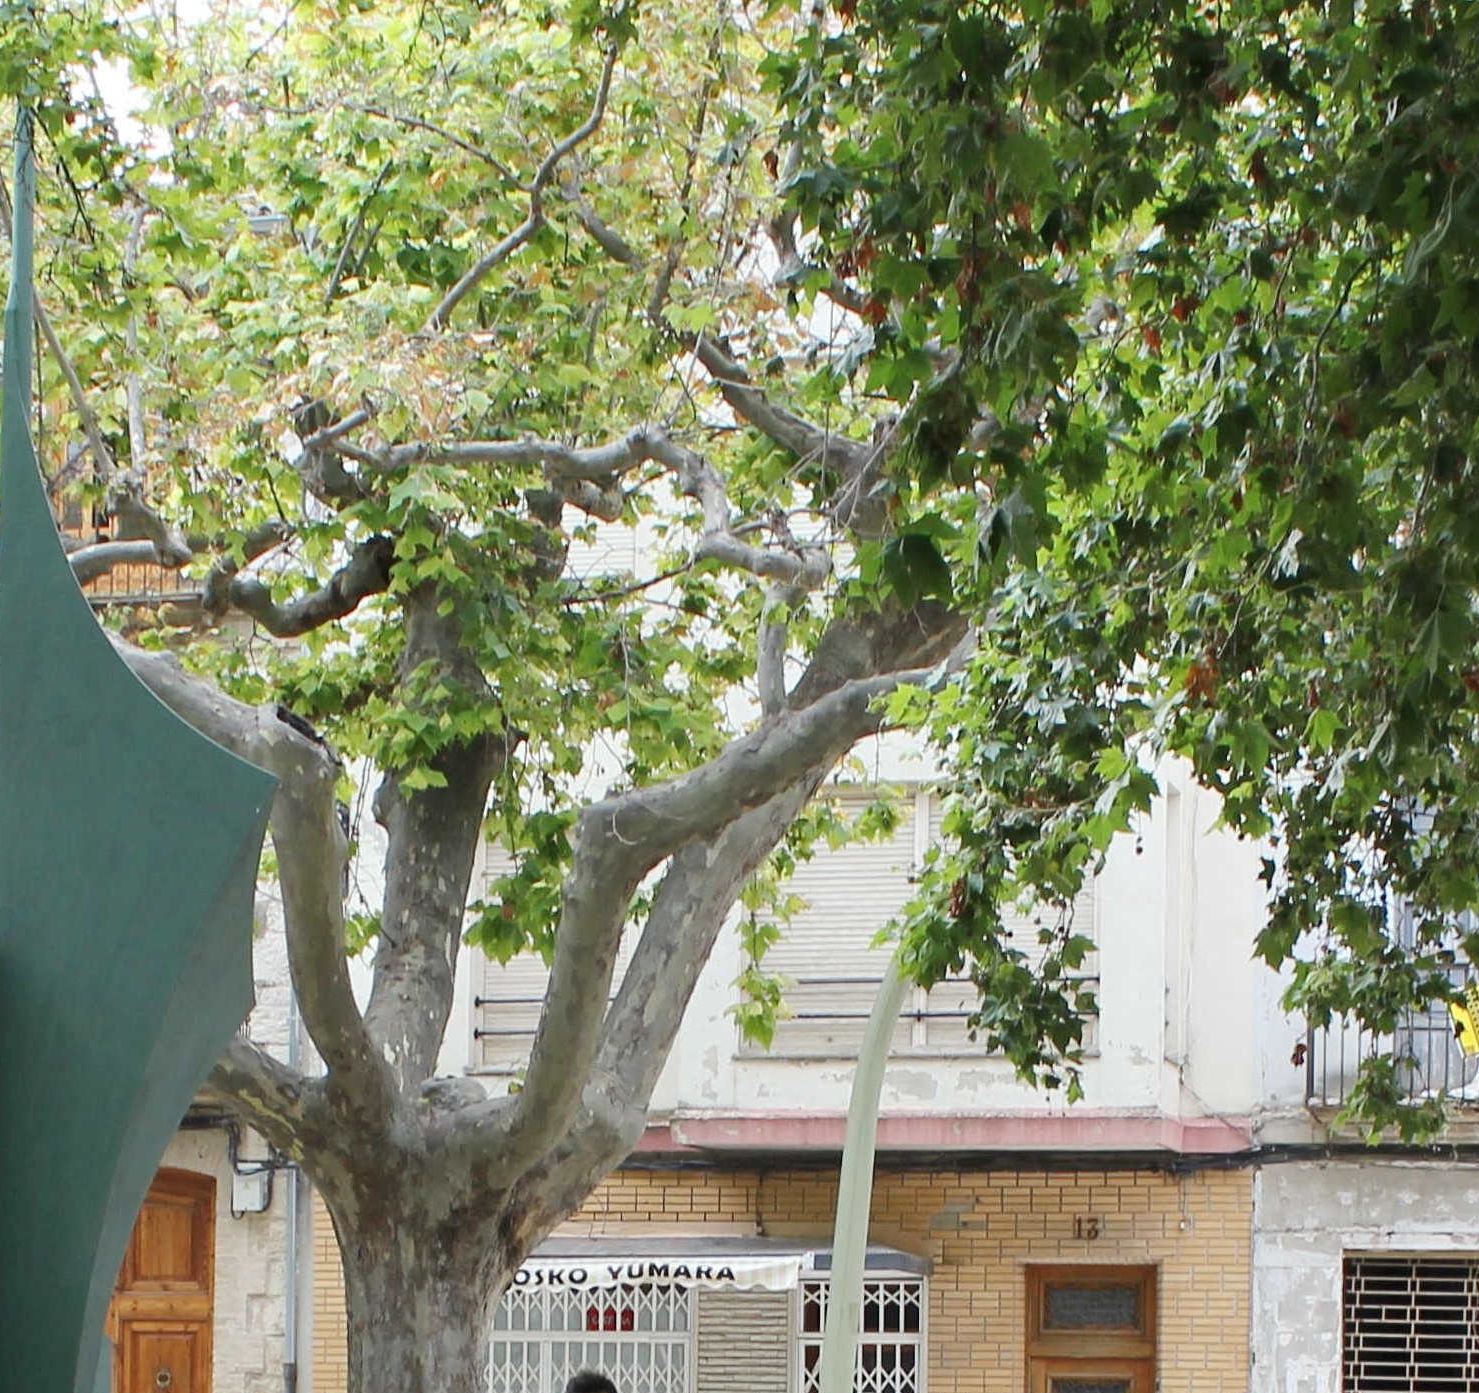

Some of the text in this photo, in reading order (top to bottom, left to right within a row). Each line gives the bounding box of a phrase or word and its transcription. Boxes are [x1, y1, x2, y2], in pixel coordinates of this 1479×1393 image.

[1074, 1216, 1099, 1240] 13
[513, 1262, 735, 1286] OSKO YUMARA
